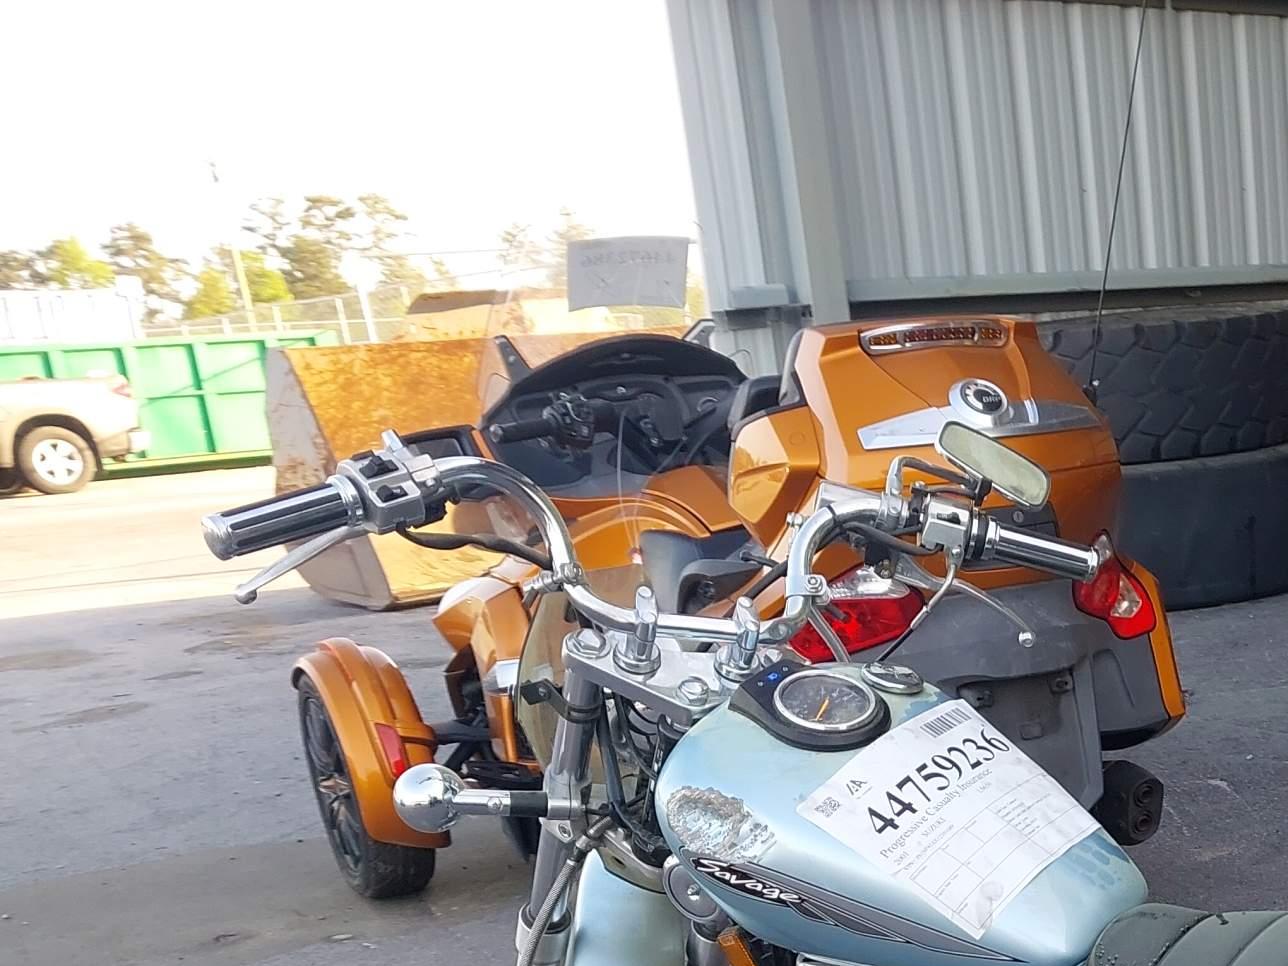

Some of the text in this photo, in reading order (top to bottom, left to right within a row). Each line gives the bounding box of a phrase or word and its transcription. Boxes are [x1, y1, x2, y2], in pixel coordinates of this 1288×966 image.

[868, 726, 1010, 834] 44759236
[880, 815, 928, 858] Progressive
[925, 787, 961, 816] Casualty
[957, 767, 993, 792] Insurance
[696, 859, 802, 903] Savage
